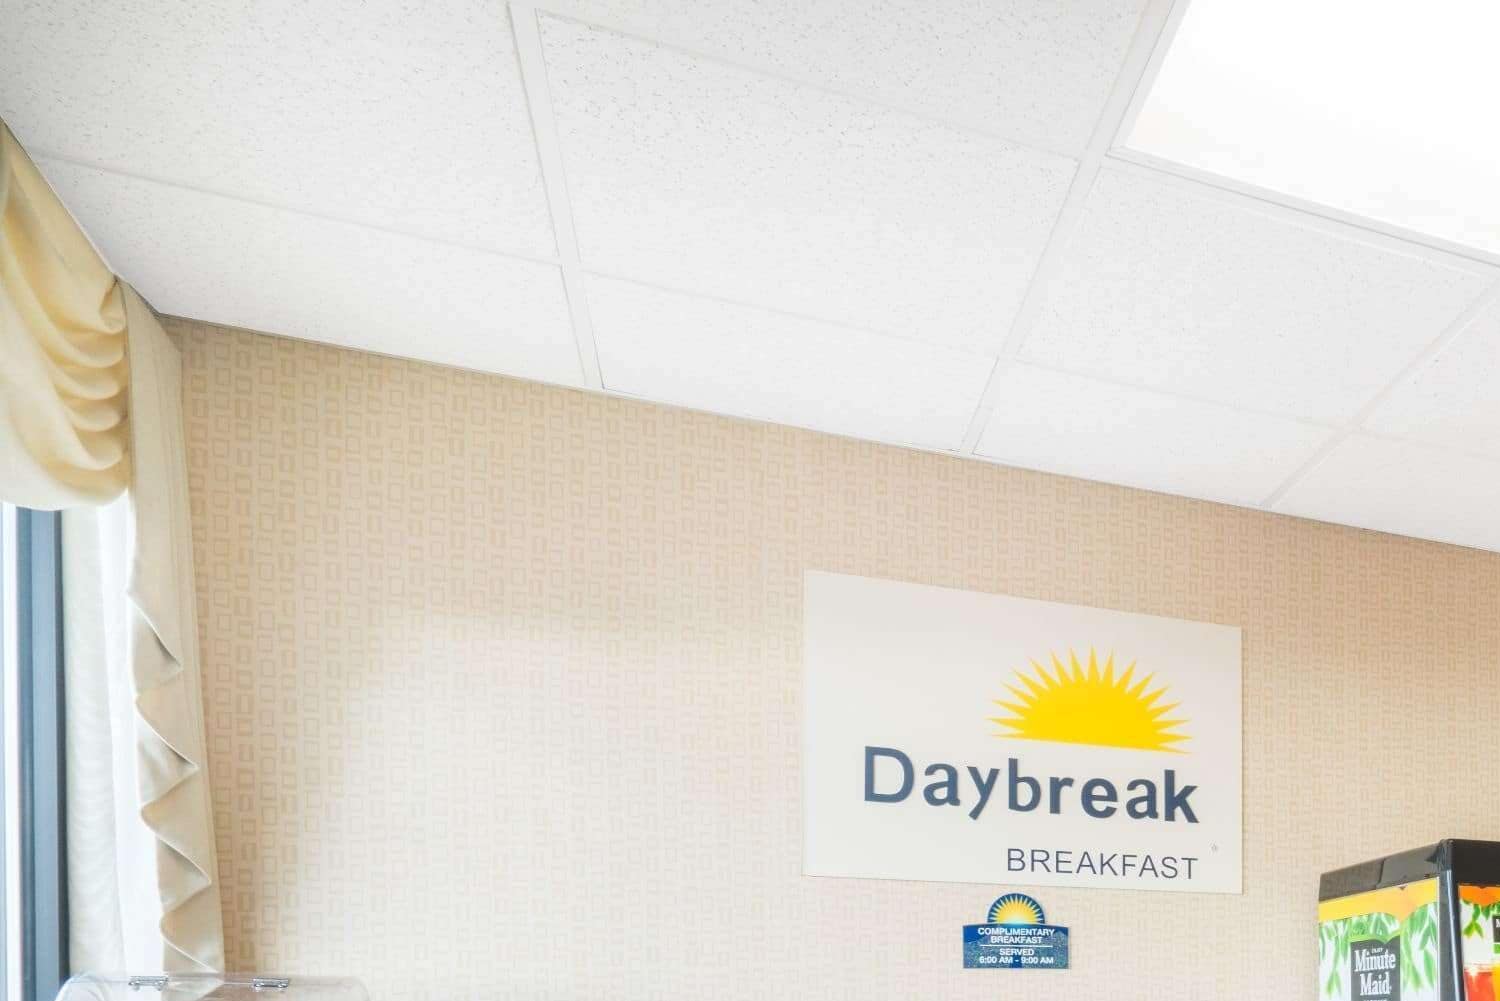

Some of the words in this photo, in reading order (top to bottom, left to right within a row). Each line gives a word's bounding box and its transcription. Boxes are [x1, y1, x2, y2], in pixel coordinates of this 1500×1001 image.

[864, 745, 1200, 823] Daybreak
[1007, 847, 1199, 880] BREAKFAST
[977, 927, 1055, 936] COMPLIMENTARY
[991, 935, 1043, 944] BREAKFAST
[979, 956, 998, 964] 6:00
[999, 956, 1013, 964] AM
[1021, 956, 1038, 964] 9:00
[999, 948, 1035, 956] SERVED
[1354, 948, 1396, 972] Minute
[1360, 971, 1391, 996] Maid
